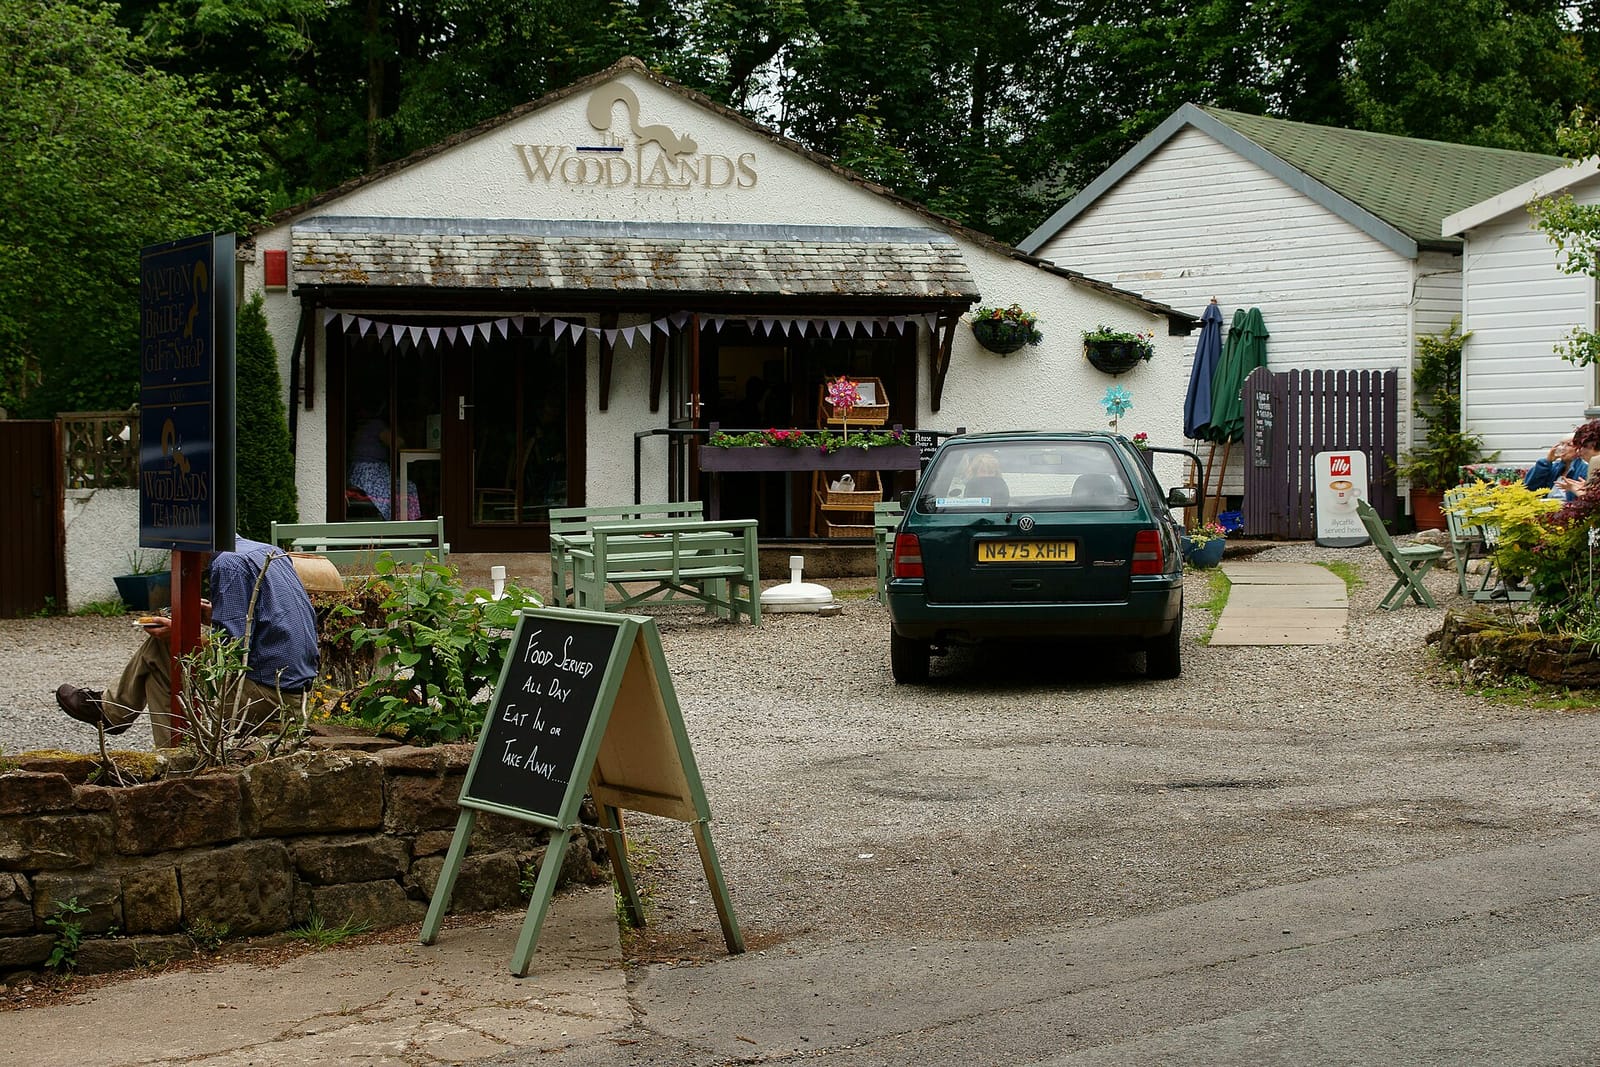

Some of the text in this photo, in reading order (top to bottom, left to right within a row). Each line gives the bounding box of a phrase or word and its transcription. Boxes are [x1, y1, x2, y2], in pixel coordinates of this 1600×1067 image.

[598, 132, 629, 147] The
[513, 143, 758, 189] WOODLANDS
[144, 264, 191, 304] SANTON
[1332, 458, 1350, 475] illy
[143, 469, 208, 502] WOODLANDS
[1324, 526, 1362, 534] served here
[985, 543, 1068, 559] N475 XHH
